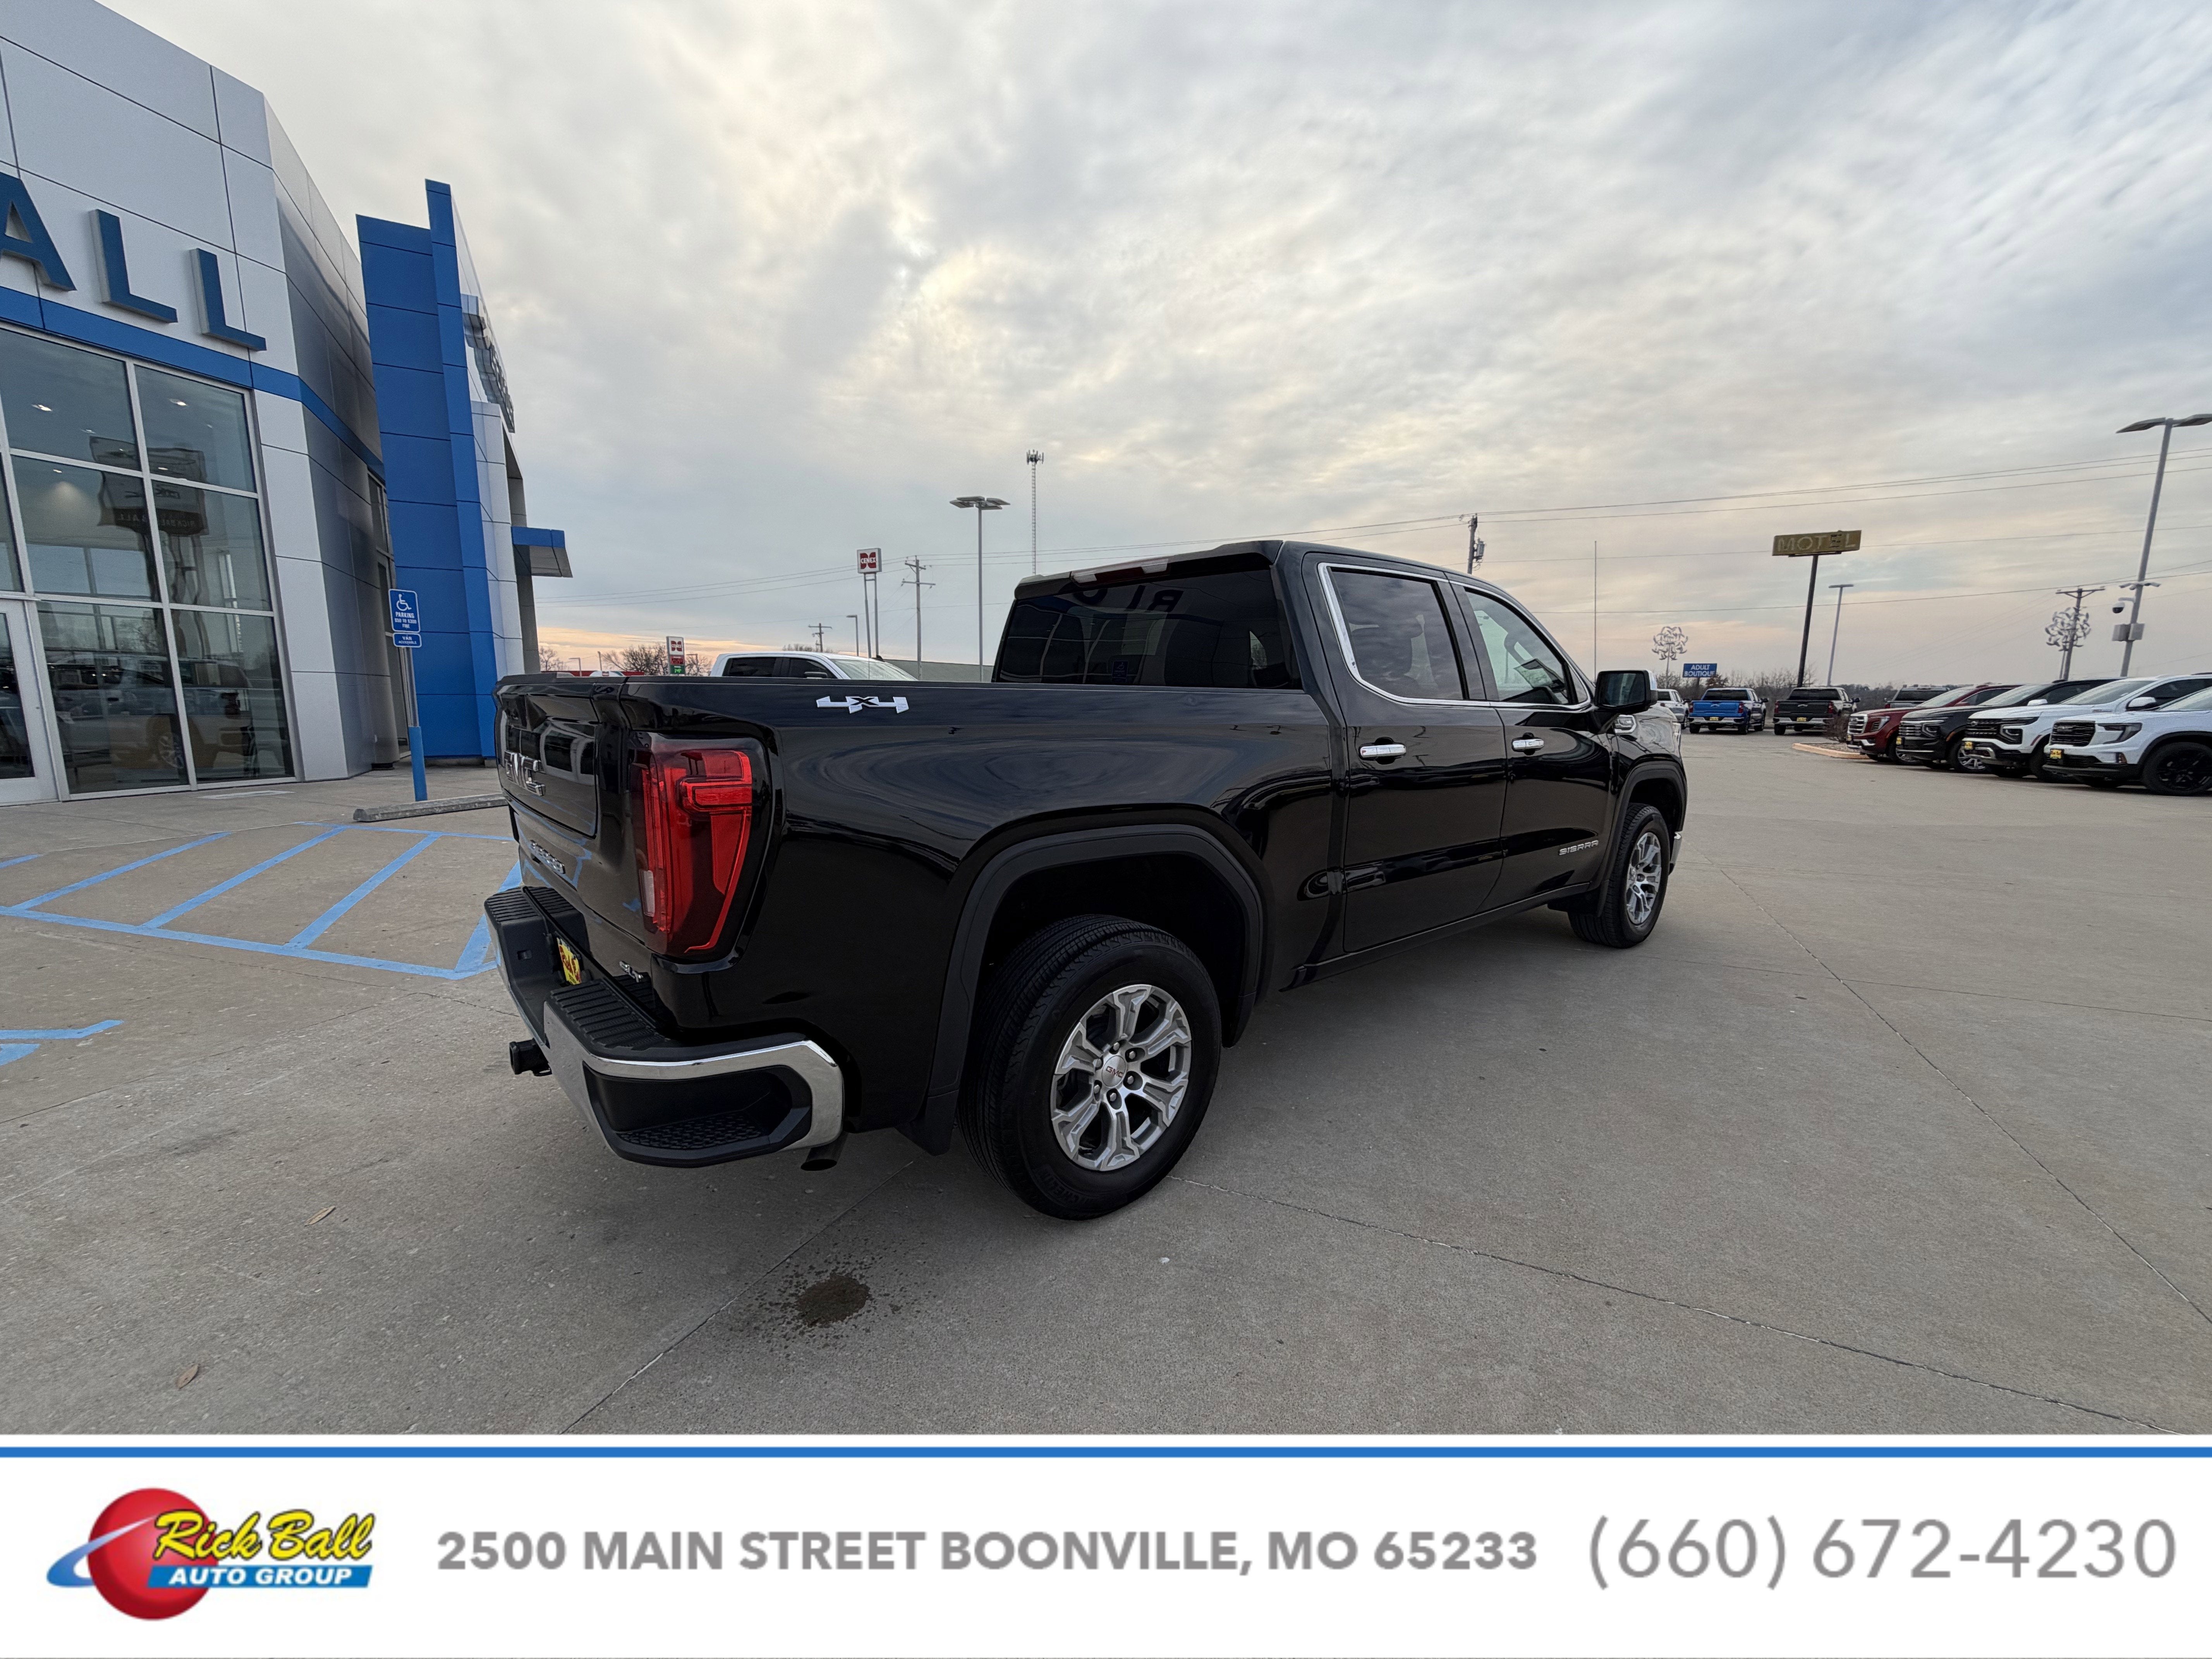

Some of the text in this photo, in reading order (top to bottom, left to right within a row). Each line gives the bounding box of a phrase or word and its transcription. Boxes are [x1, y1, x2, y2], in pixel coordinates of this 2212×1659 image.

[1777, 533, 1856, 551] MOTEL
[1559, 840, 1599, 855] SIERRA
[1105, 1065, 1124, 1079] GMC
